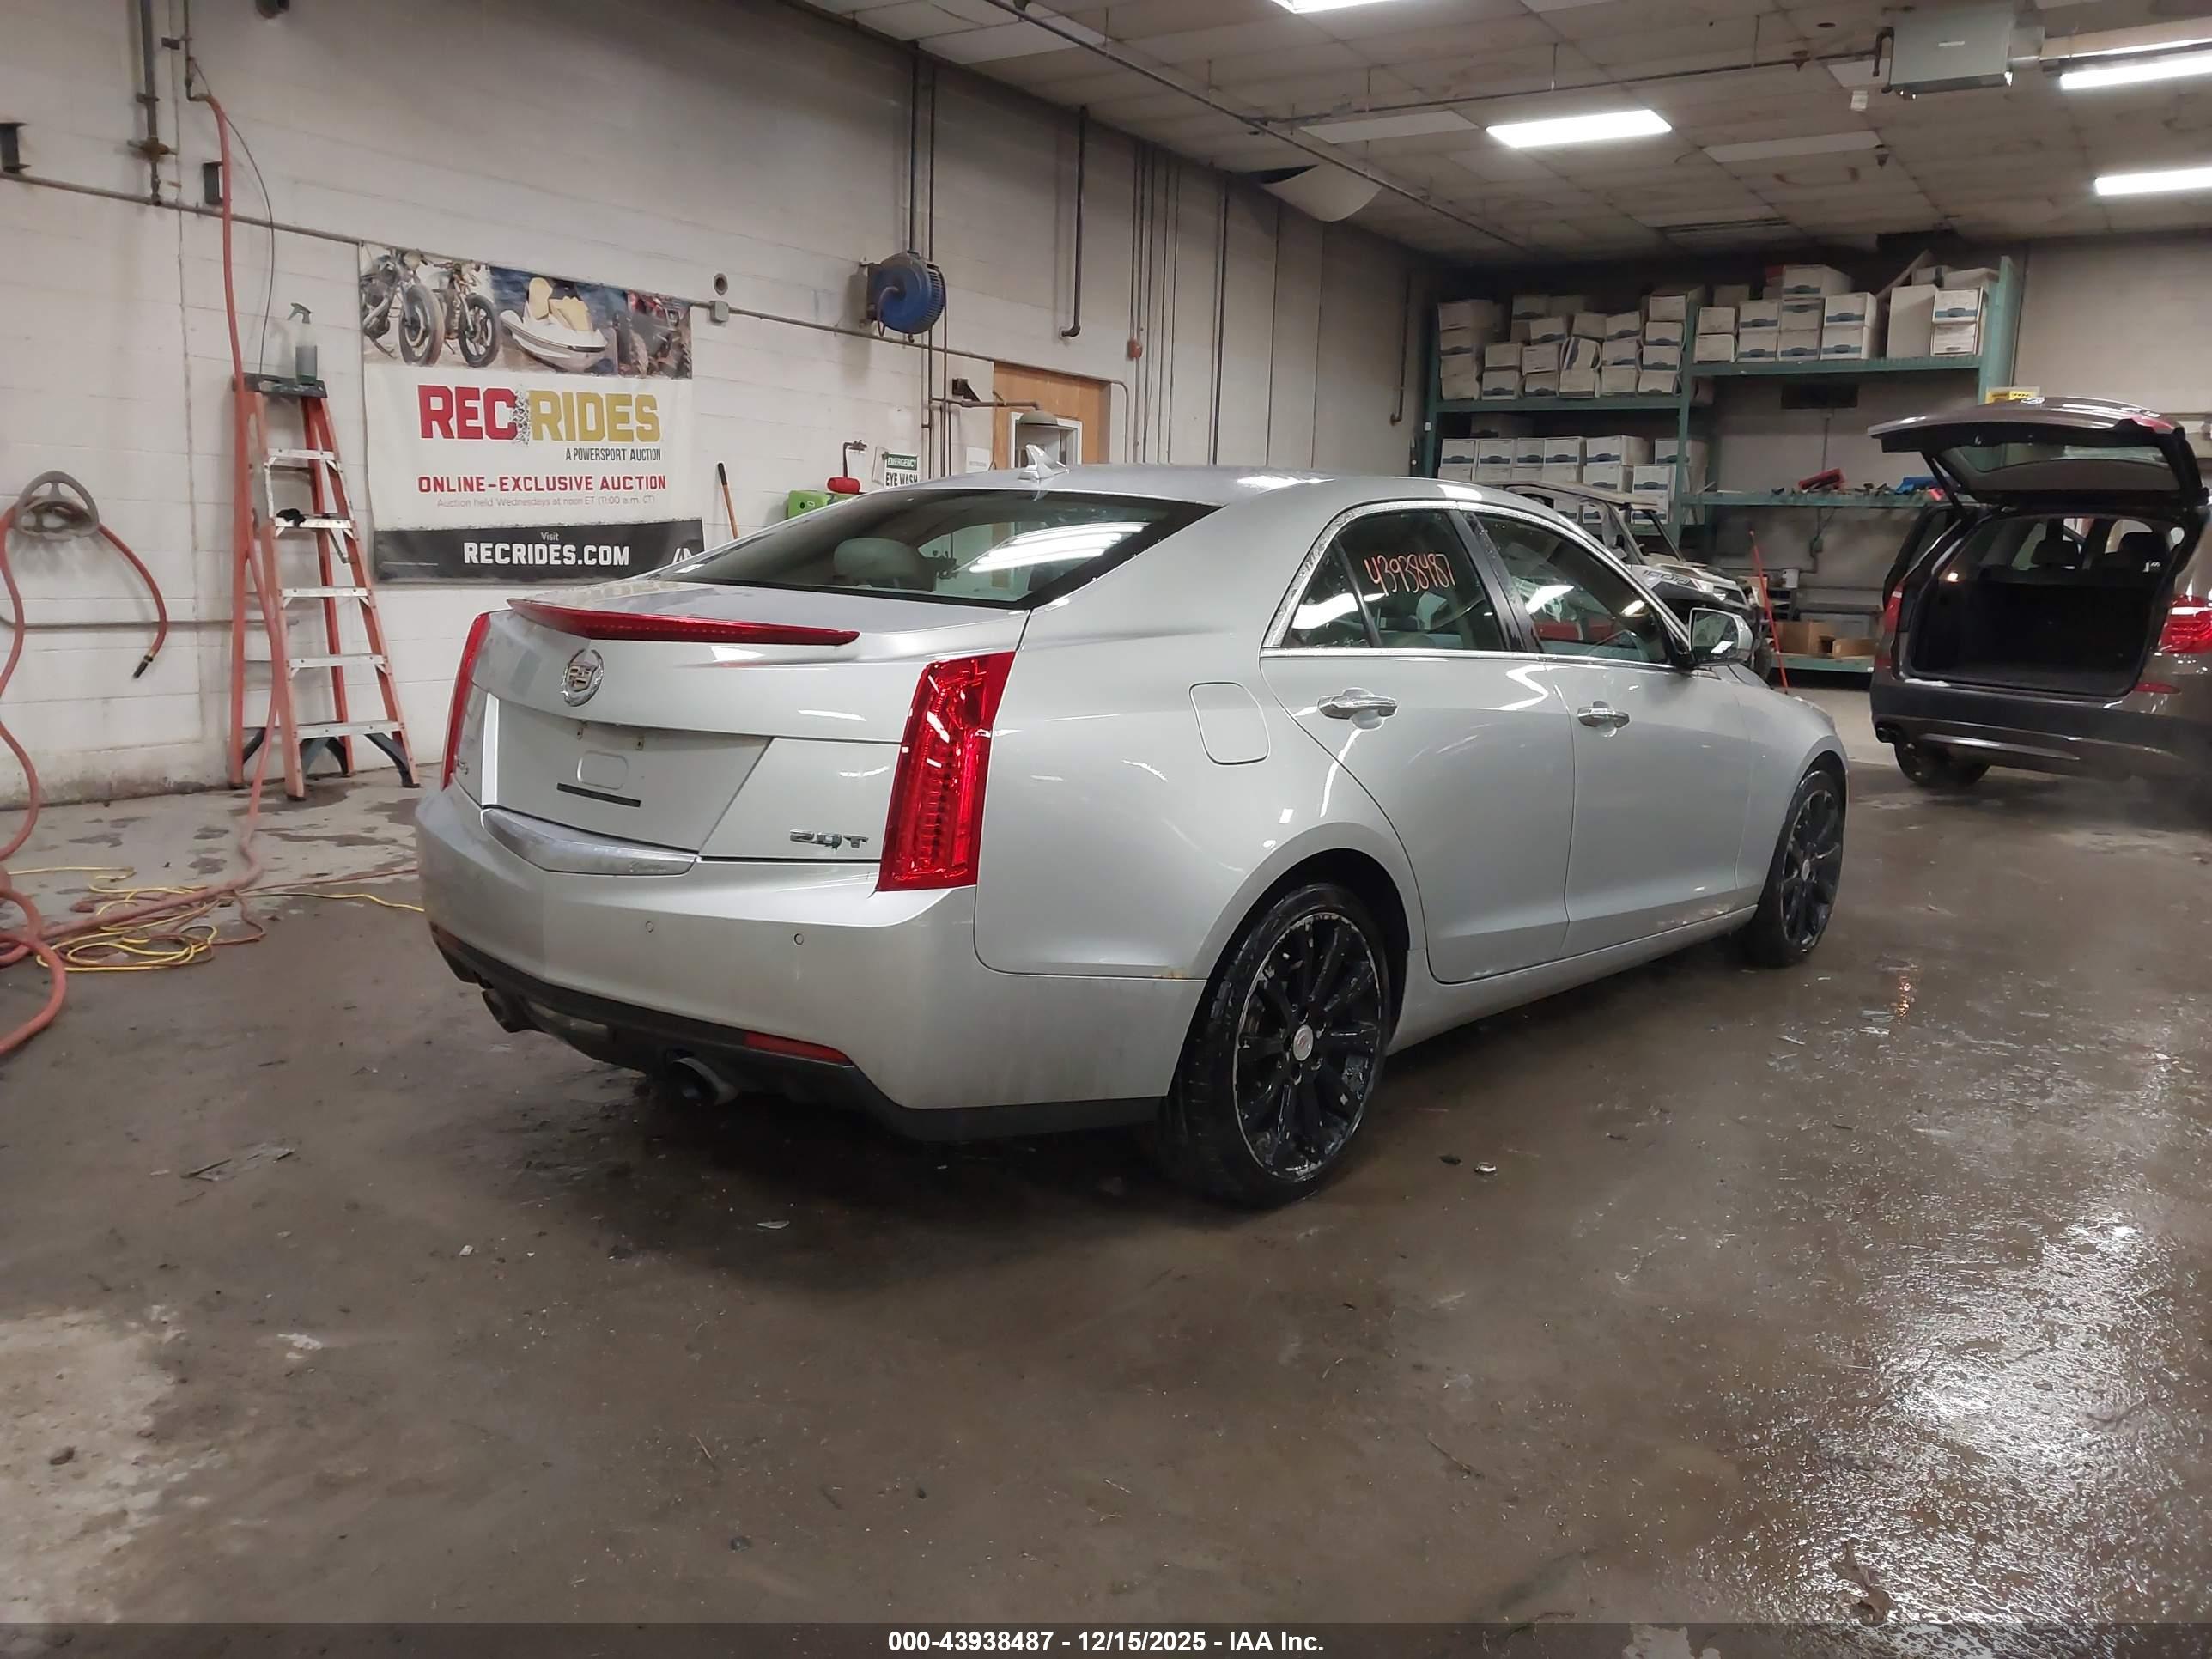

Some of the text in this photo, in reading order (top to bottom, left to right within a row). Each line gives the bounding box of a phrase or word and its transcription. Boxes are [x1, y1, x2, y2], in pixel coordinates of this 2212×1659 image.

[418, 385, 660, 442] REC RIDES
[566, 448, 660, 461] A POWERSPORT AUCTION
[887, 457, 916, 468] EMERGENCY
[418, 475, 666, 493] ONLINE-EXCLUSIVE AUCTION
[886, 472, 898, 487] EYE
[437, 498, 471, 507] Auction
[474, 498, 493, 507] held
[496, 497, 550, 507] Wednesdays
[552, 497, 561, 506] at
[585, 496, 594, 505] ET
[540, 532, 560, 541] Visit
[464, 543, 629, 567] RECRIDES.COM
[1364, 553, 1456, 597] 43938487
